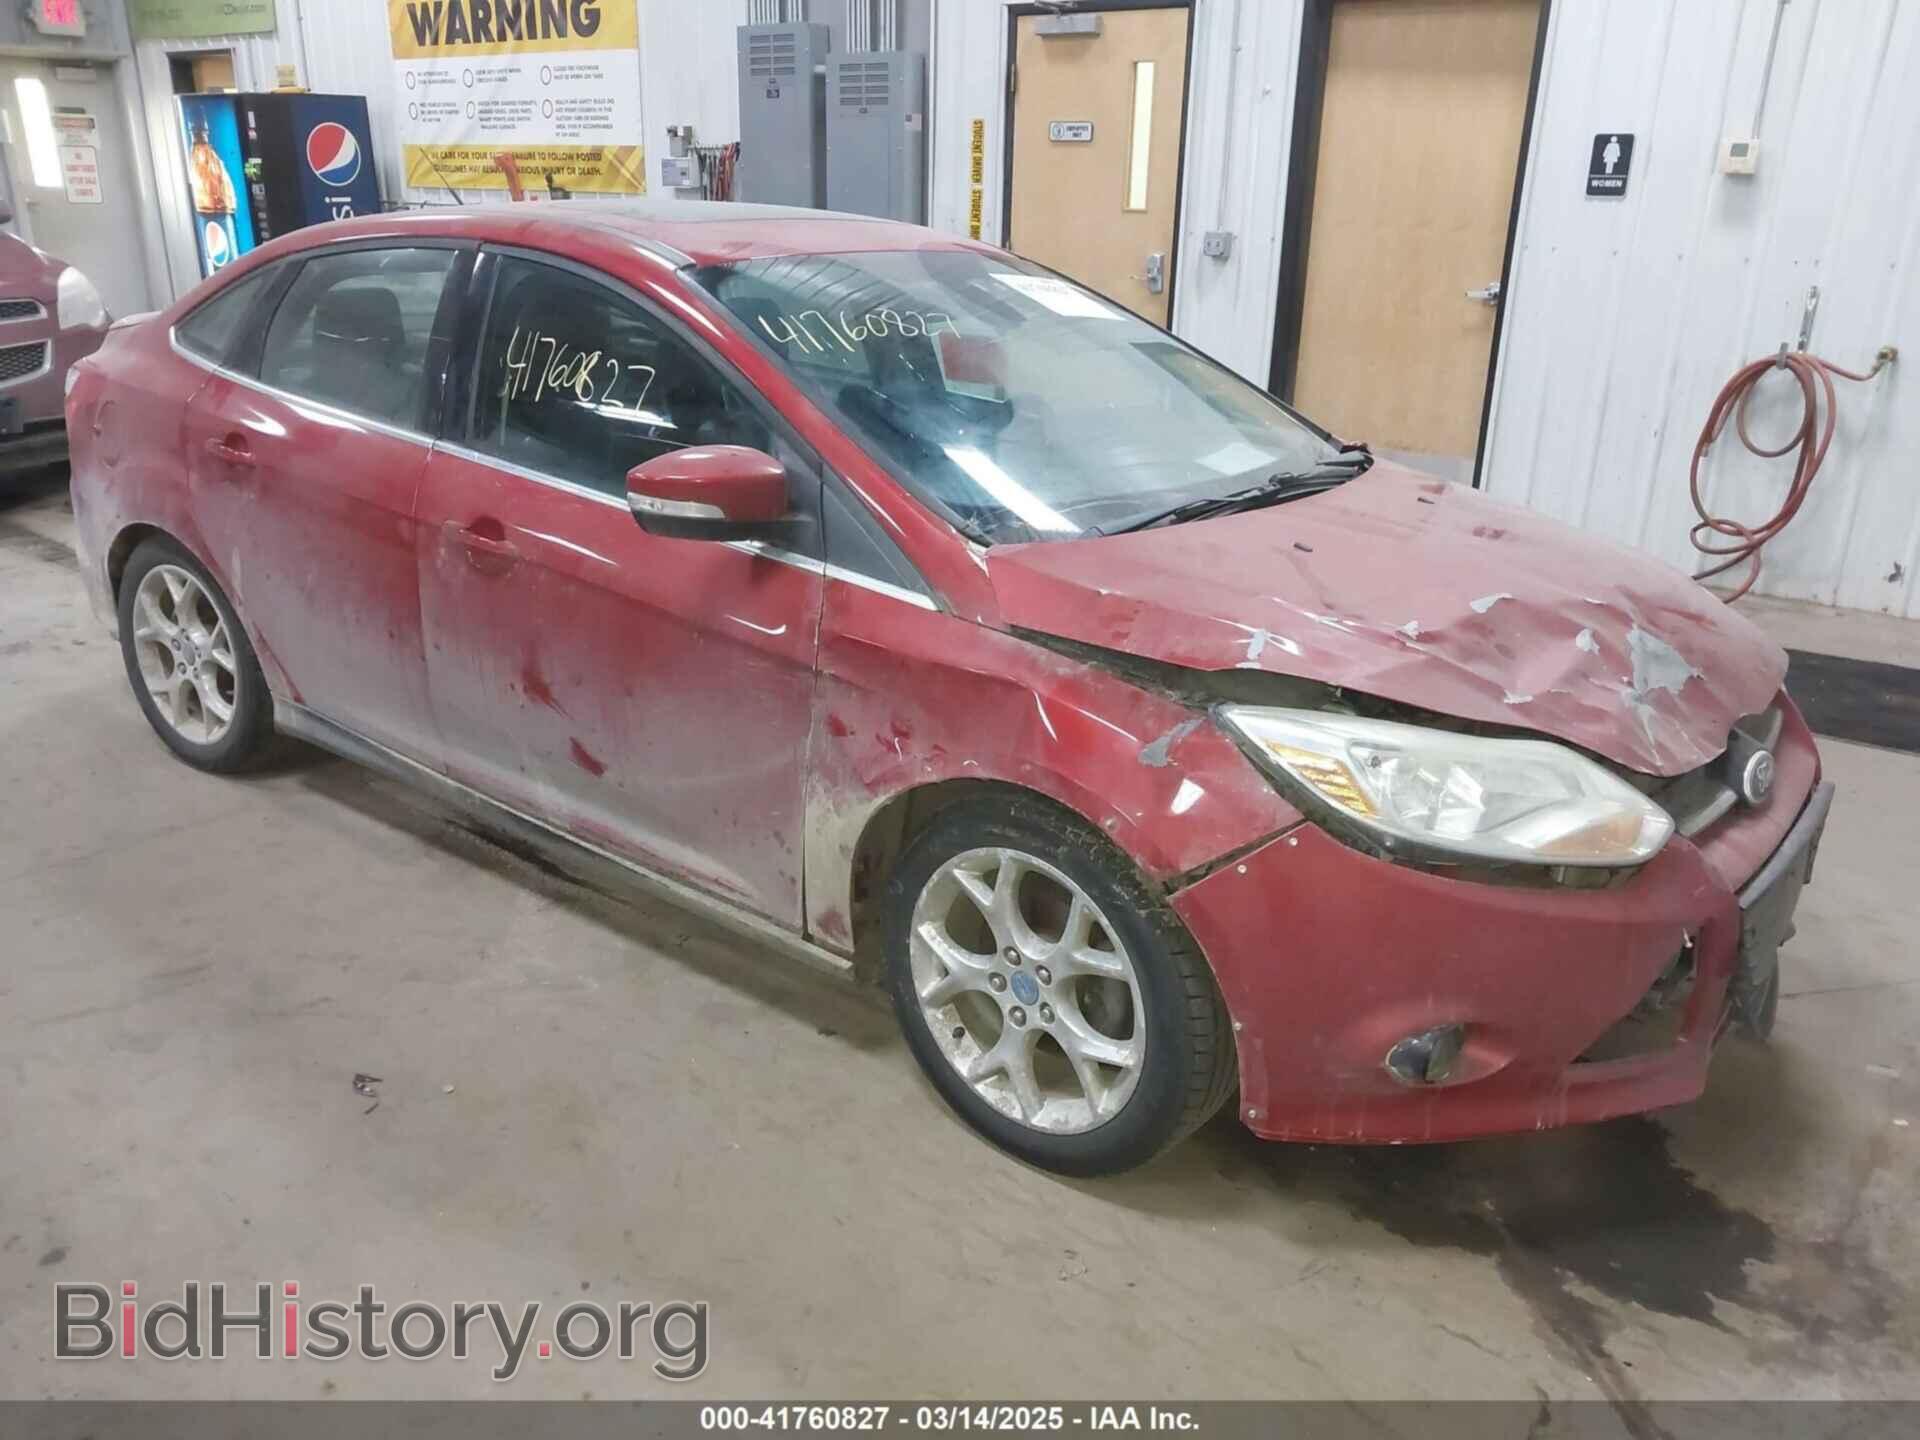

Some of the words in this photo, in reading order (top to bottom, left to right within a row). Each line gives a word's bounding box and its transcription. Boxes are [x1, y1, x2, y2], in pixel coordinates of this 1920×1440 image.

[406, 0, 601, 47] WARNING
[576, 152, 602, 161] POSTED
[1591, 179, 1623, 188] WOMEN
[506, 325, 656, 412] 41760827
